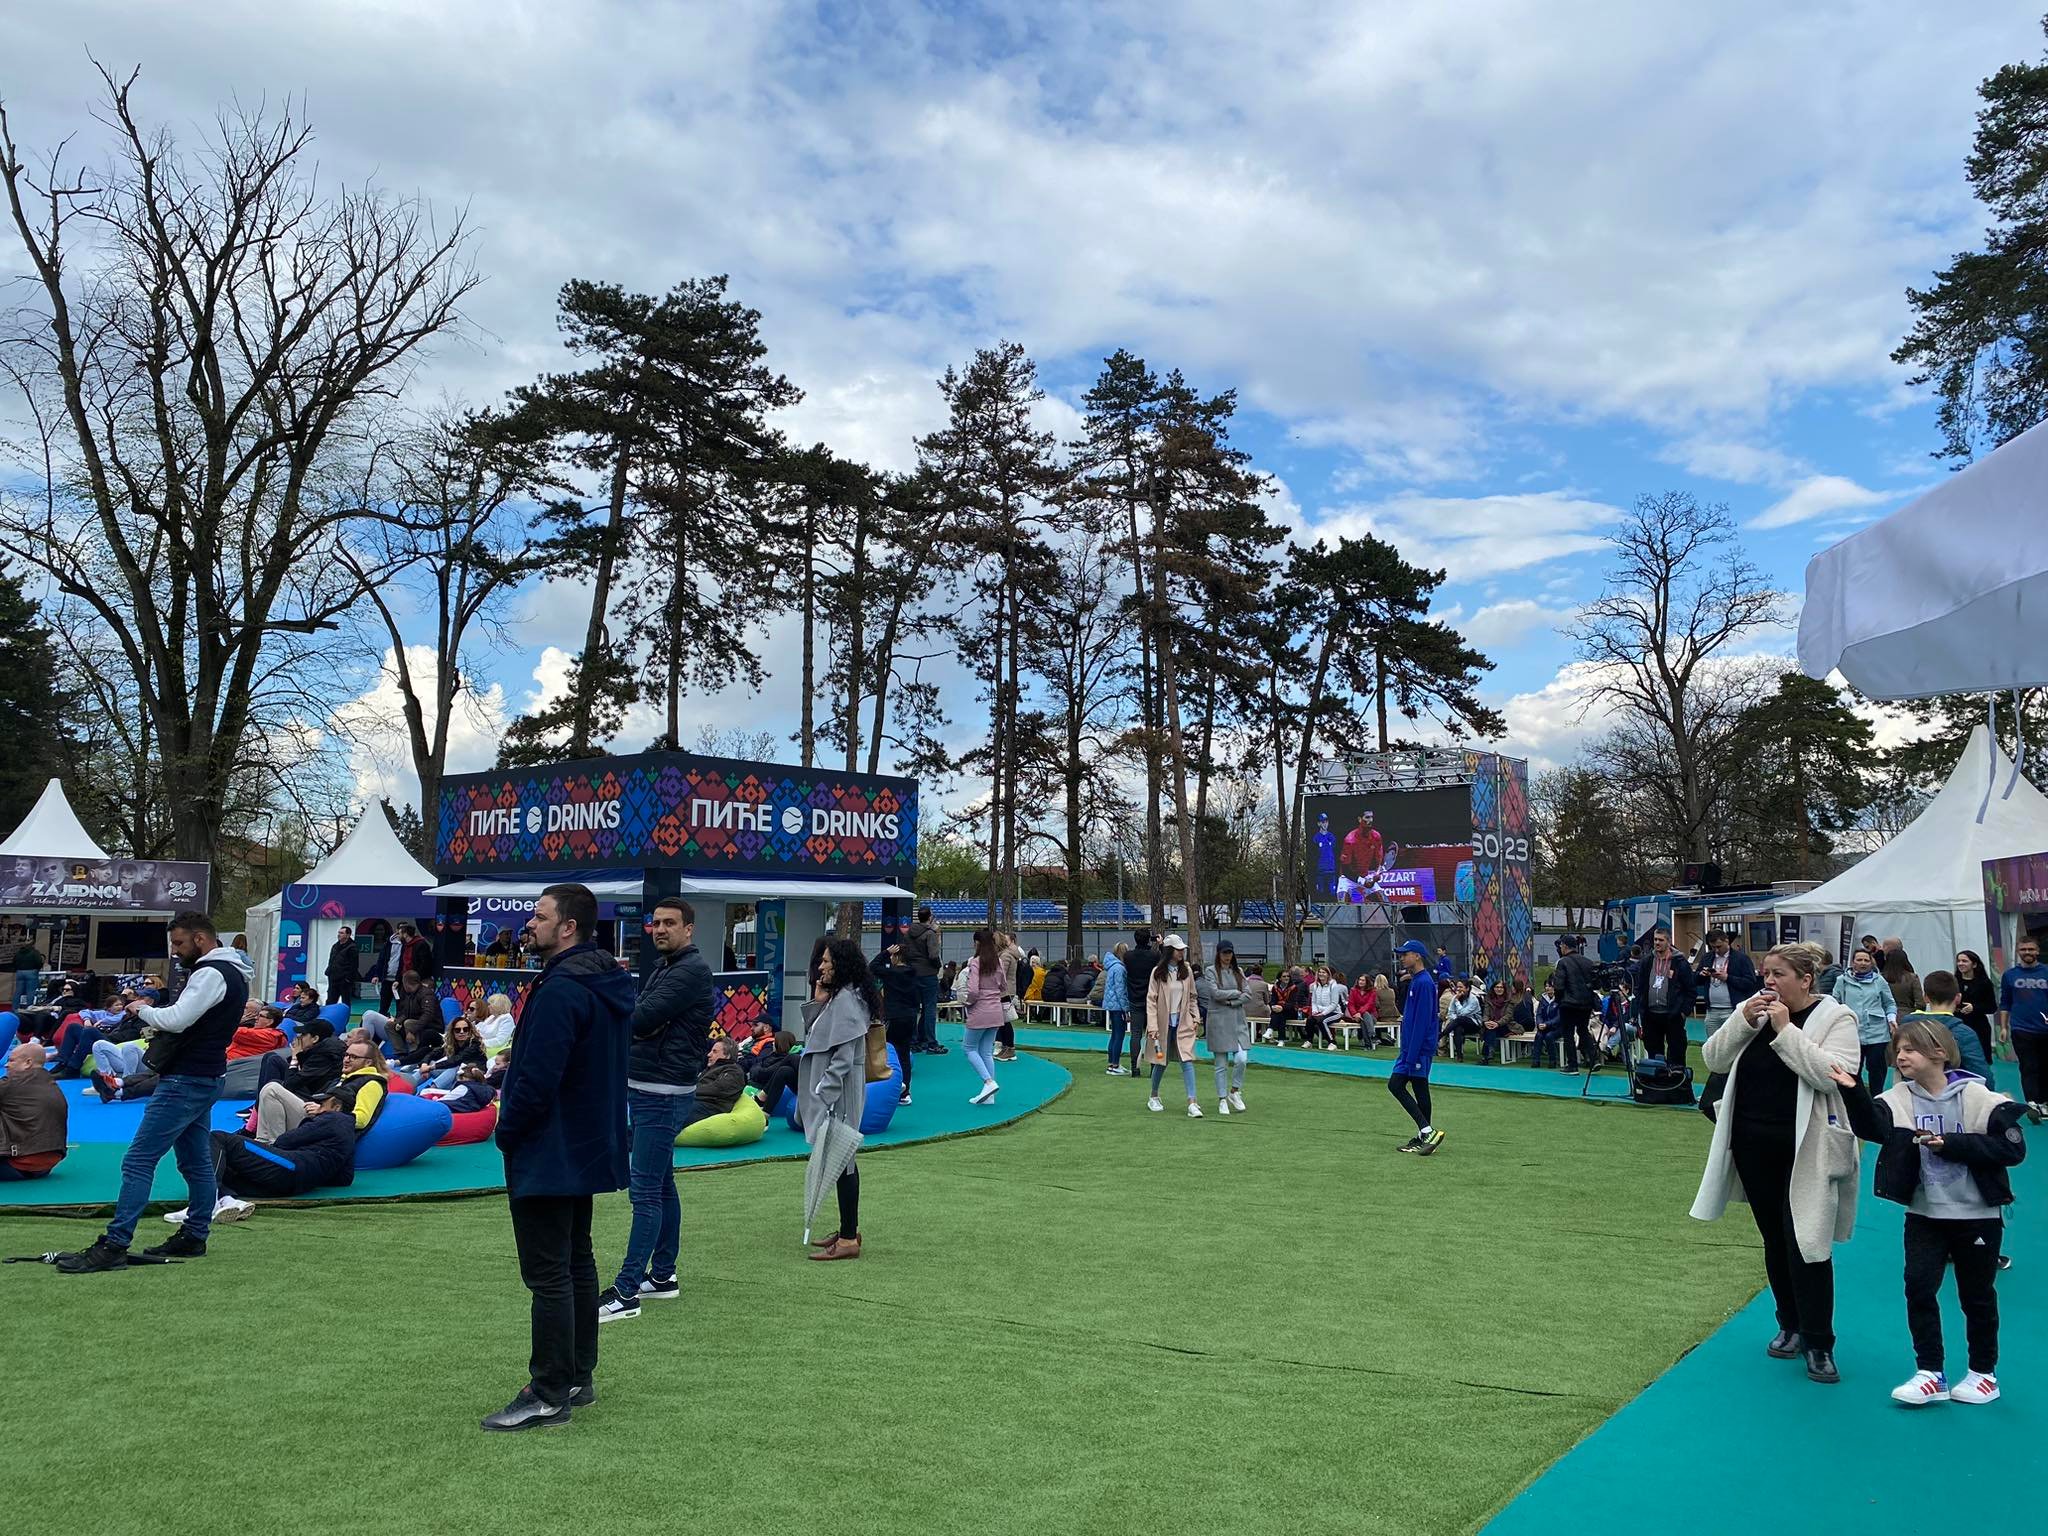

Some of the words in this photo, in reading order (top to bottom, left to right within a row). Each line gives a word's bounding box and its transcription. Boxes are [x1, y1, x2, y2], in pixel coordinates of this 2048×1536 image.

[470, 808, 521, 836] ПИЋЕ
[547, 800, 621, 832] DRINKS
[691, 798, 773, 832] ПИЋЕ
[812, 808, 899, 840] DRINKS
[31, 883, 122, 899] ZAJEDNO!
[168, 881, 197, 897] 22
[1396, 887, 1416, 896] TIME
[486, 897, 539, 912] Cubes
[291, 939, 300, 947] JS
